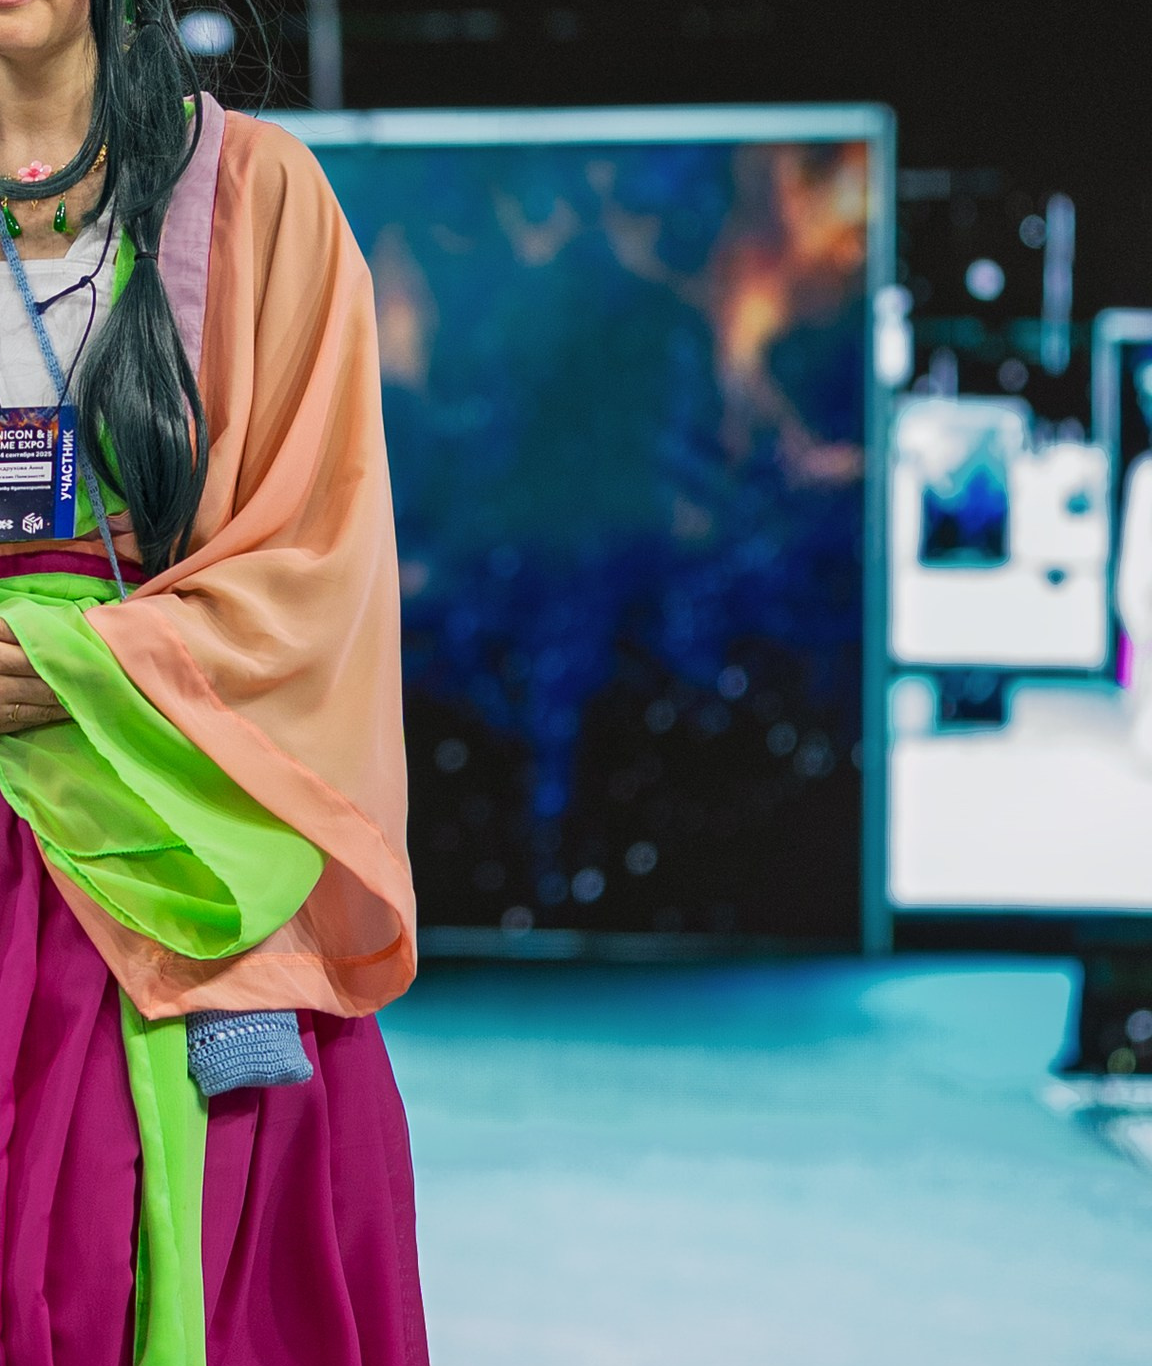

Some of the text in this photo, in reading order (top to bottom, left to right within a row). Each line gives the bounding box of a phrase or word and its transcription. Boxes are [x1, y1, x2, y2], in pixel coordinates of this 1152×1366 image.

[36, 429, 45, 439] &
[18, 440, 45, 449] EXPO
[35, 450, 53, 458] 2025
[61, 429, 75, 501] УЧАСТНИК
